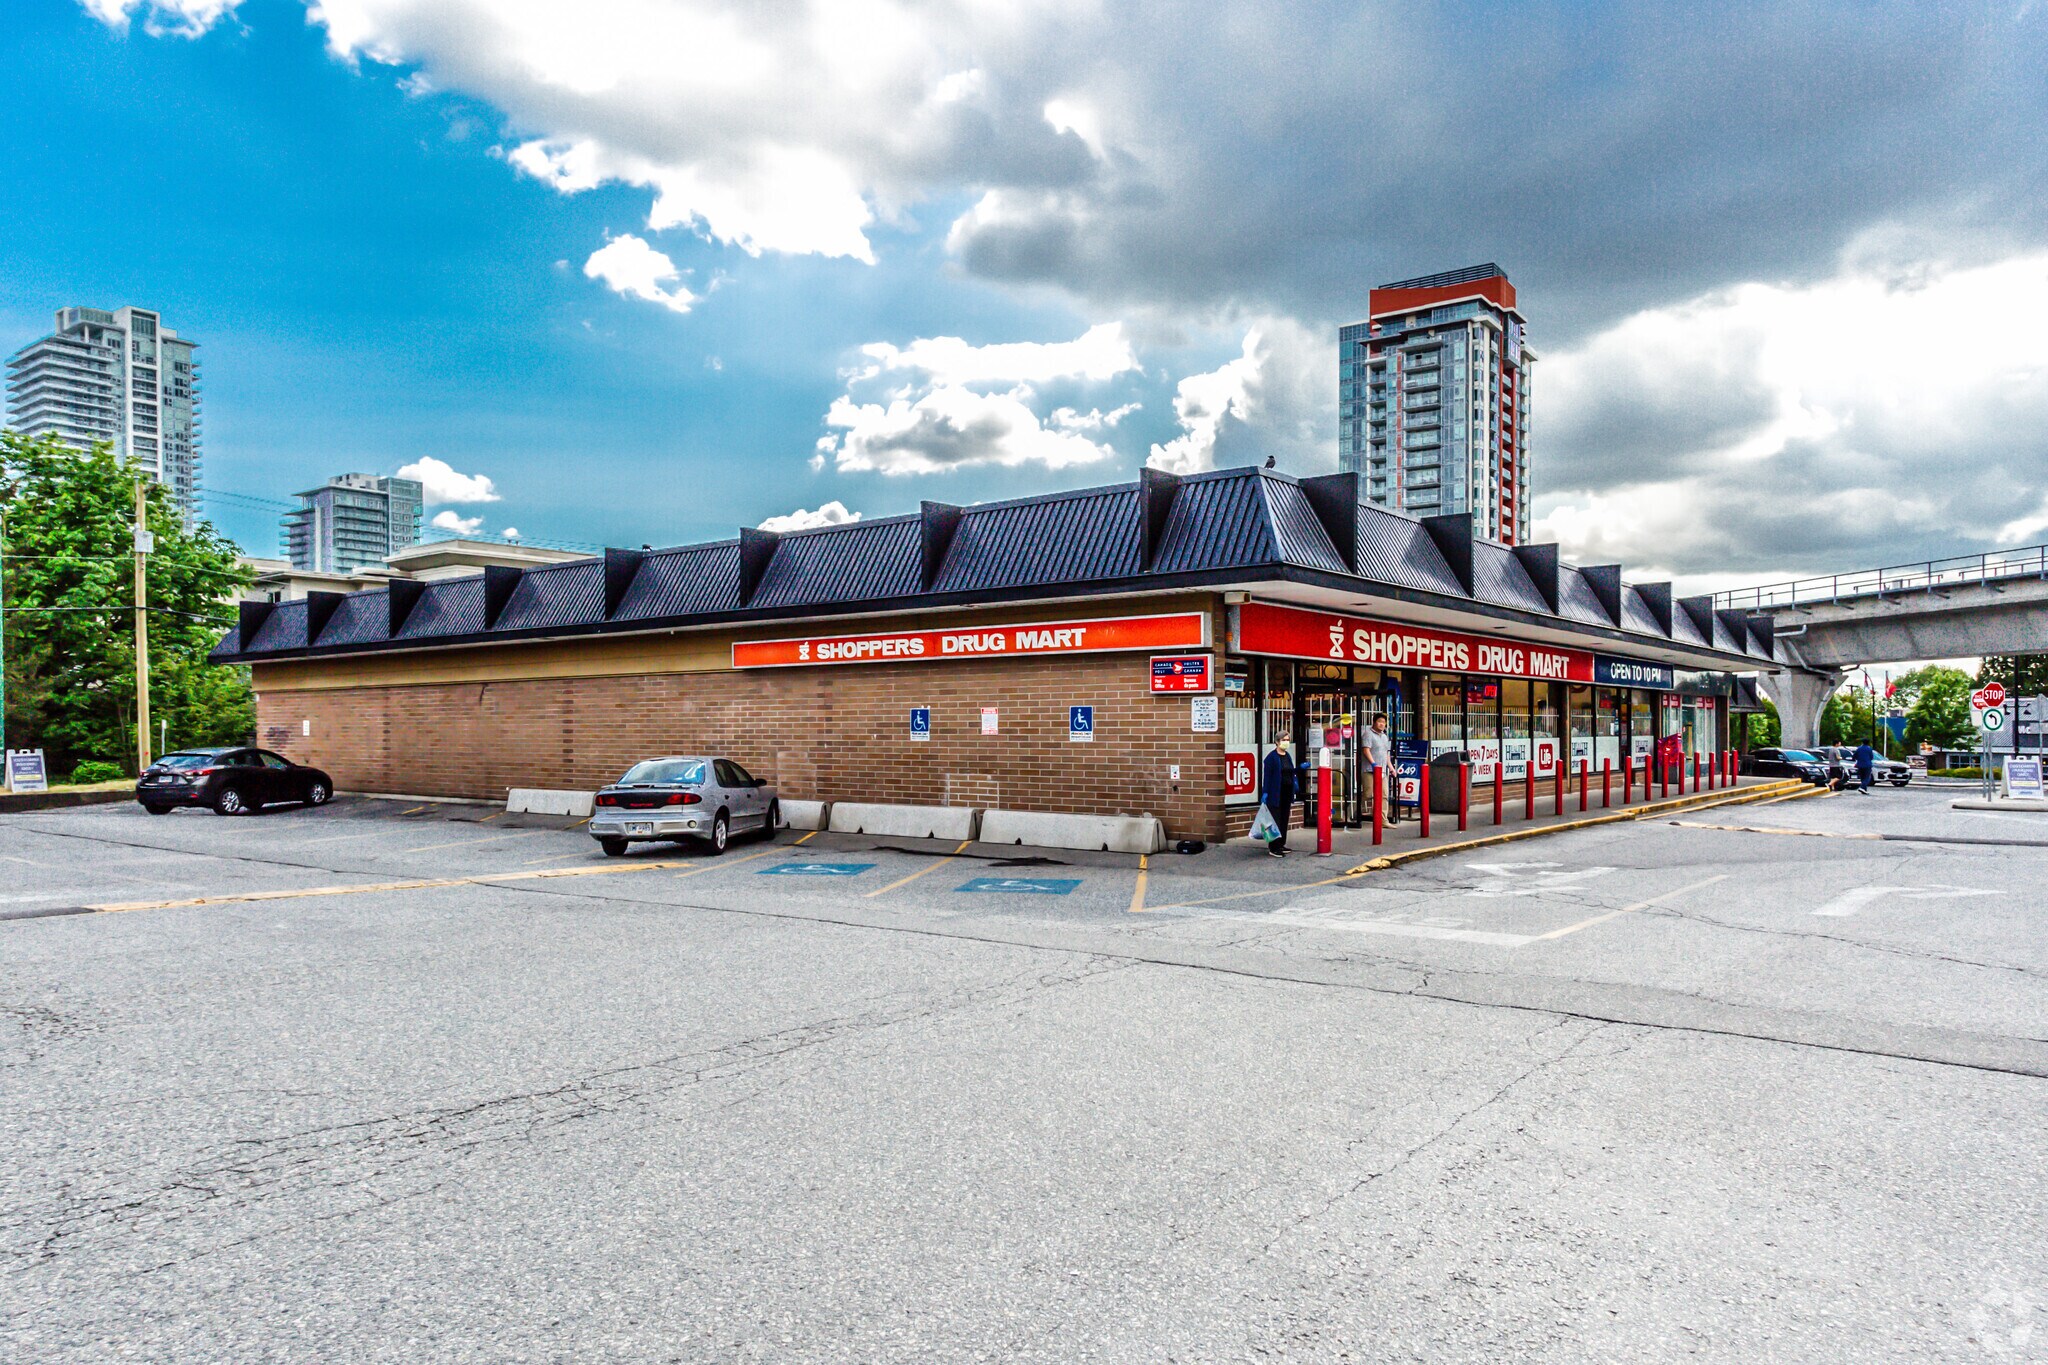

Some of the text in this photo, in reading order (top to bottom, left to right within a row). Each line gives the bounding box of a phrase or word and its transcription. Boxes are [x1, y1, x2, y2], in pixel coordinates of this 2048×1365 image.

[817, 628, 1087, 659] SHOPPERS DRUG MART
[1353, 629, 1470, 671] SHOPPERS
[1478, 645, 1524, 674] DRUG
[1530, 652, 1569, 679] MART
[1610, 662, 1662, 683] OPEN TO 10 PM
[1984, 690, 2003, 700] STOP
[1481, 745, 1486, 762] 7
[1486, 748, 1498, 759] DAYS
[1540, 748, 1552, 765] Life
[1226, 761, 1251, 786] Life
[1478, 764, 1492, 775] WEEK
[1505, 763, 1525, 775] pharmacy
